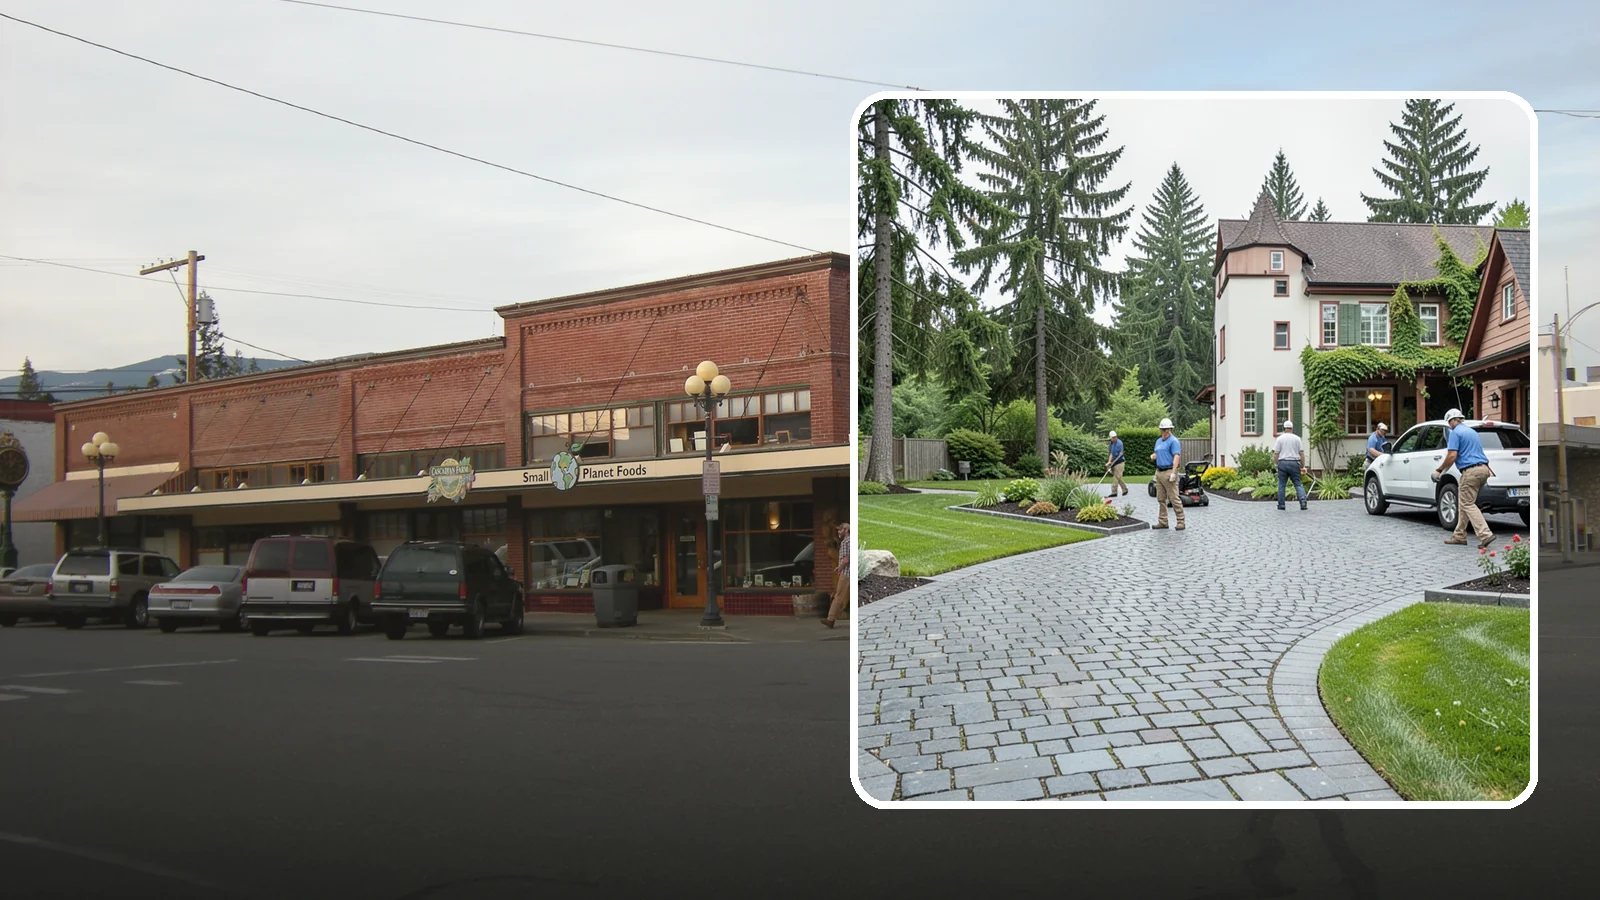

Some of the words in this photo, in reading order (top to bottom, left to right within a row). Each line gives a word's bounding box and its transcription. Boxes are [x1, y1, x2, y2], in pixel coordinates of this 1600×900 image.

[523, 471, 549, 482] Small
[583, 467, 614, 479] Planet
[617, 464, 647, 476] Foods
